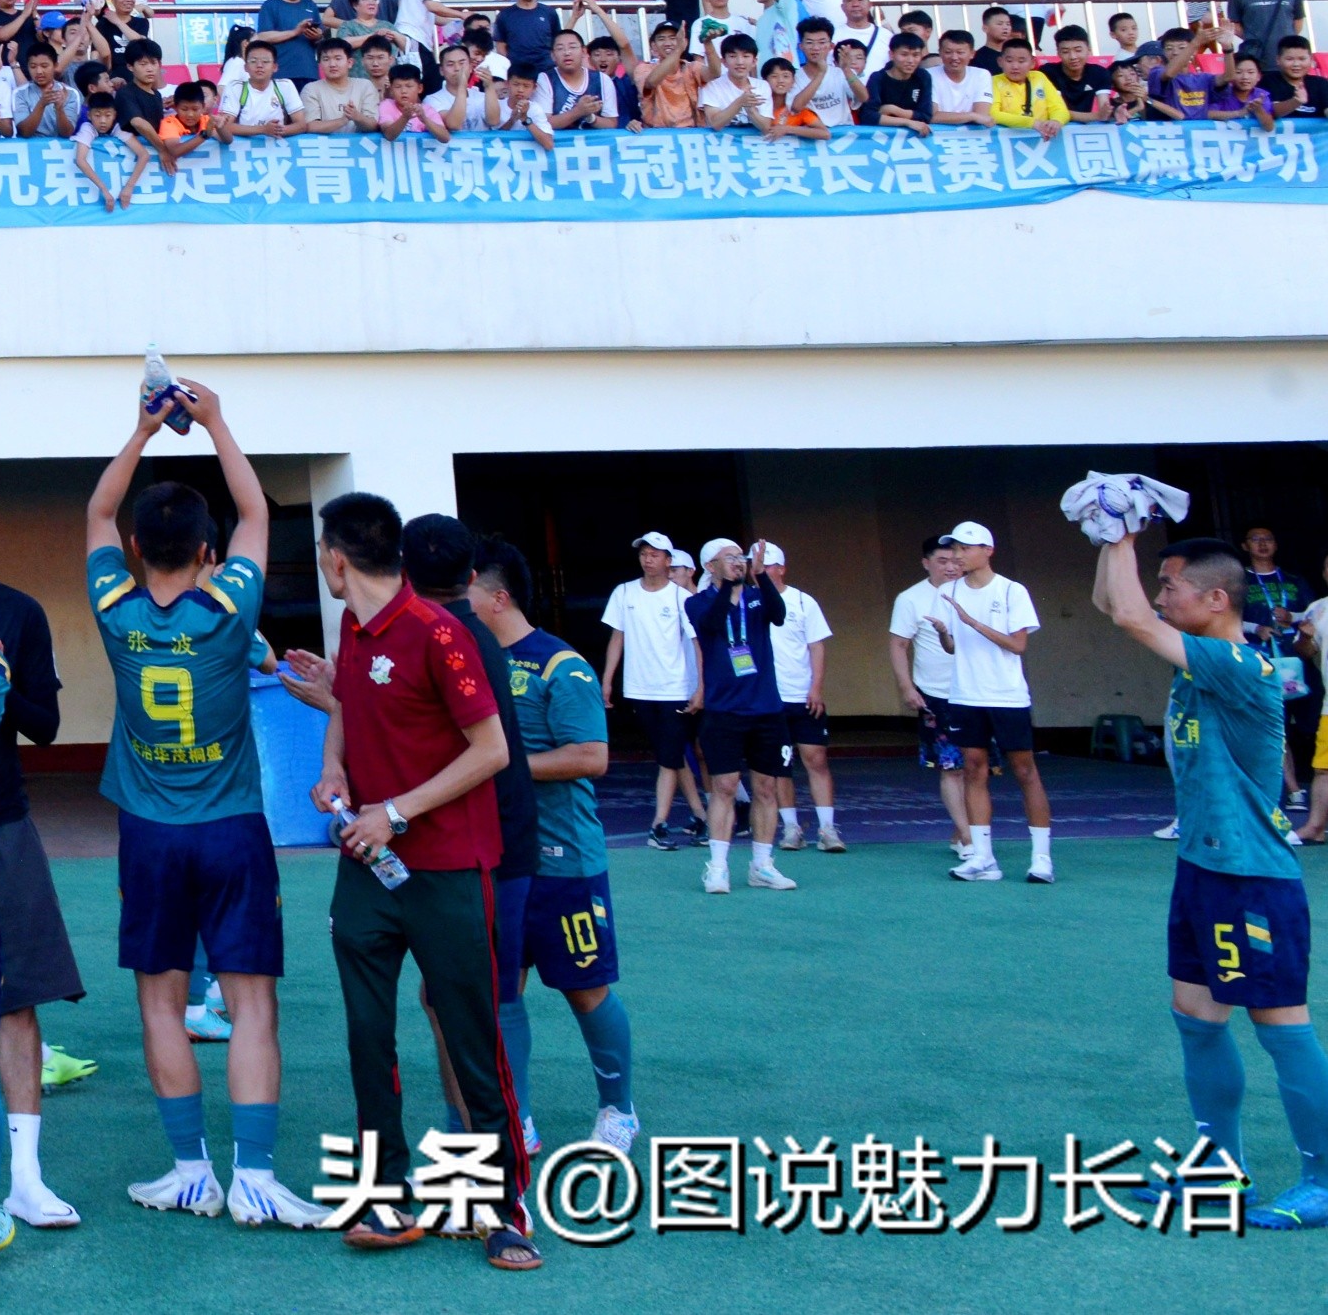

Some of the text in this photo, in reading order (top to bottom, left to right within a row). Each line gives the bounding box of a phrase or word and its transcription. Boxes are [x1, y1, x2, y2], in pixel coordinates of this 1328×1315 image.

[127, 630, 198, 656] 张波
[140, 665, 196, 748] 9
[560, 911, 598, 954] 10
[1214, 923, 1240, 969] 5
